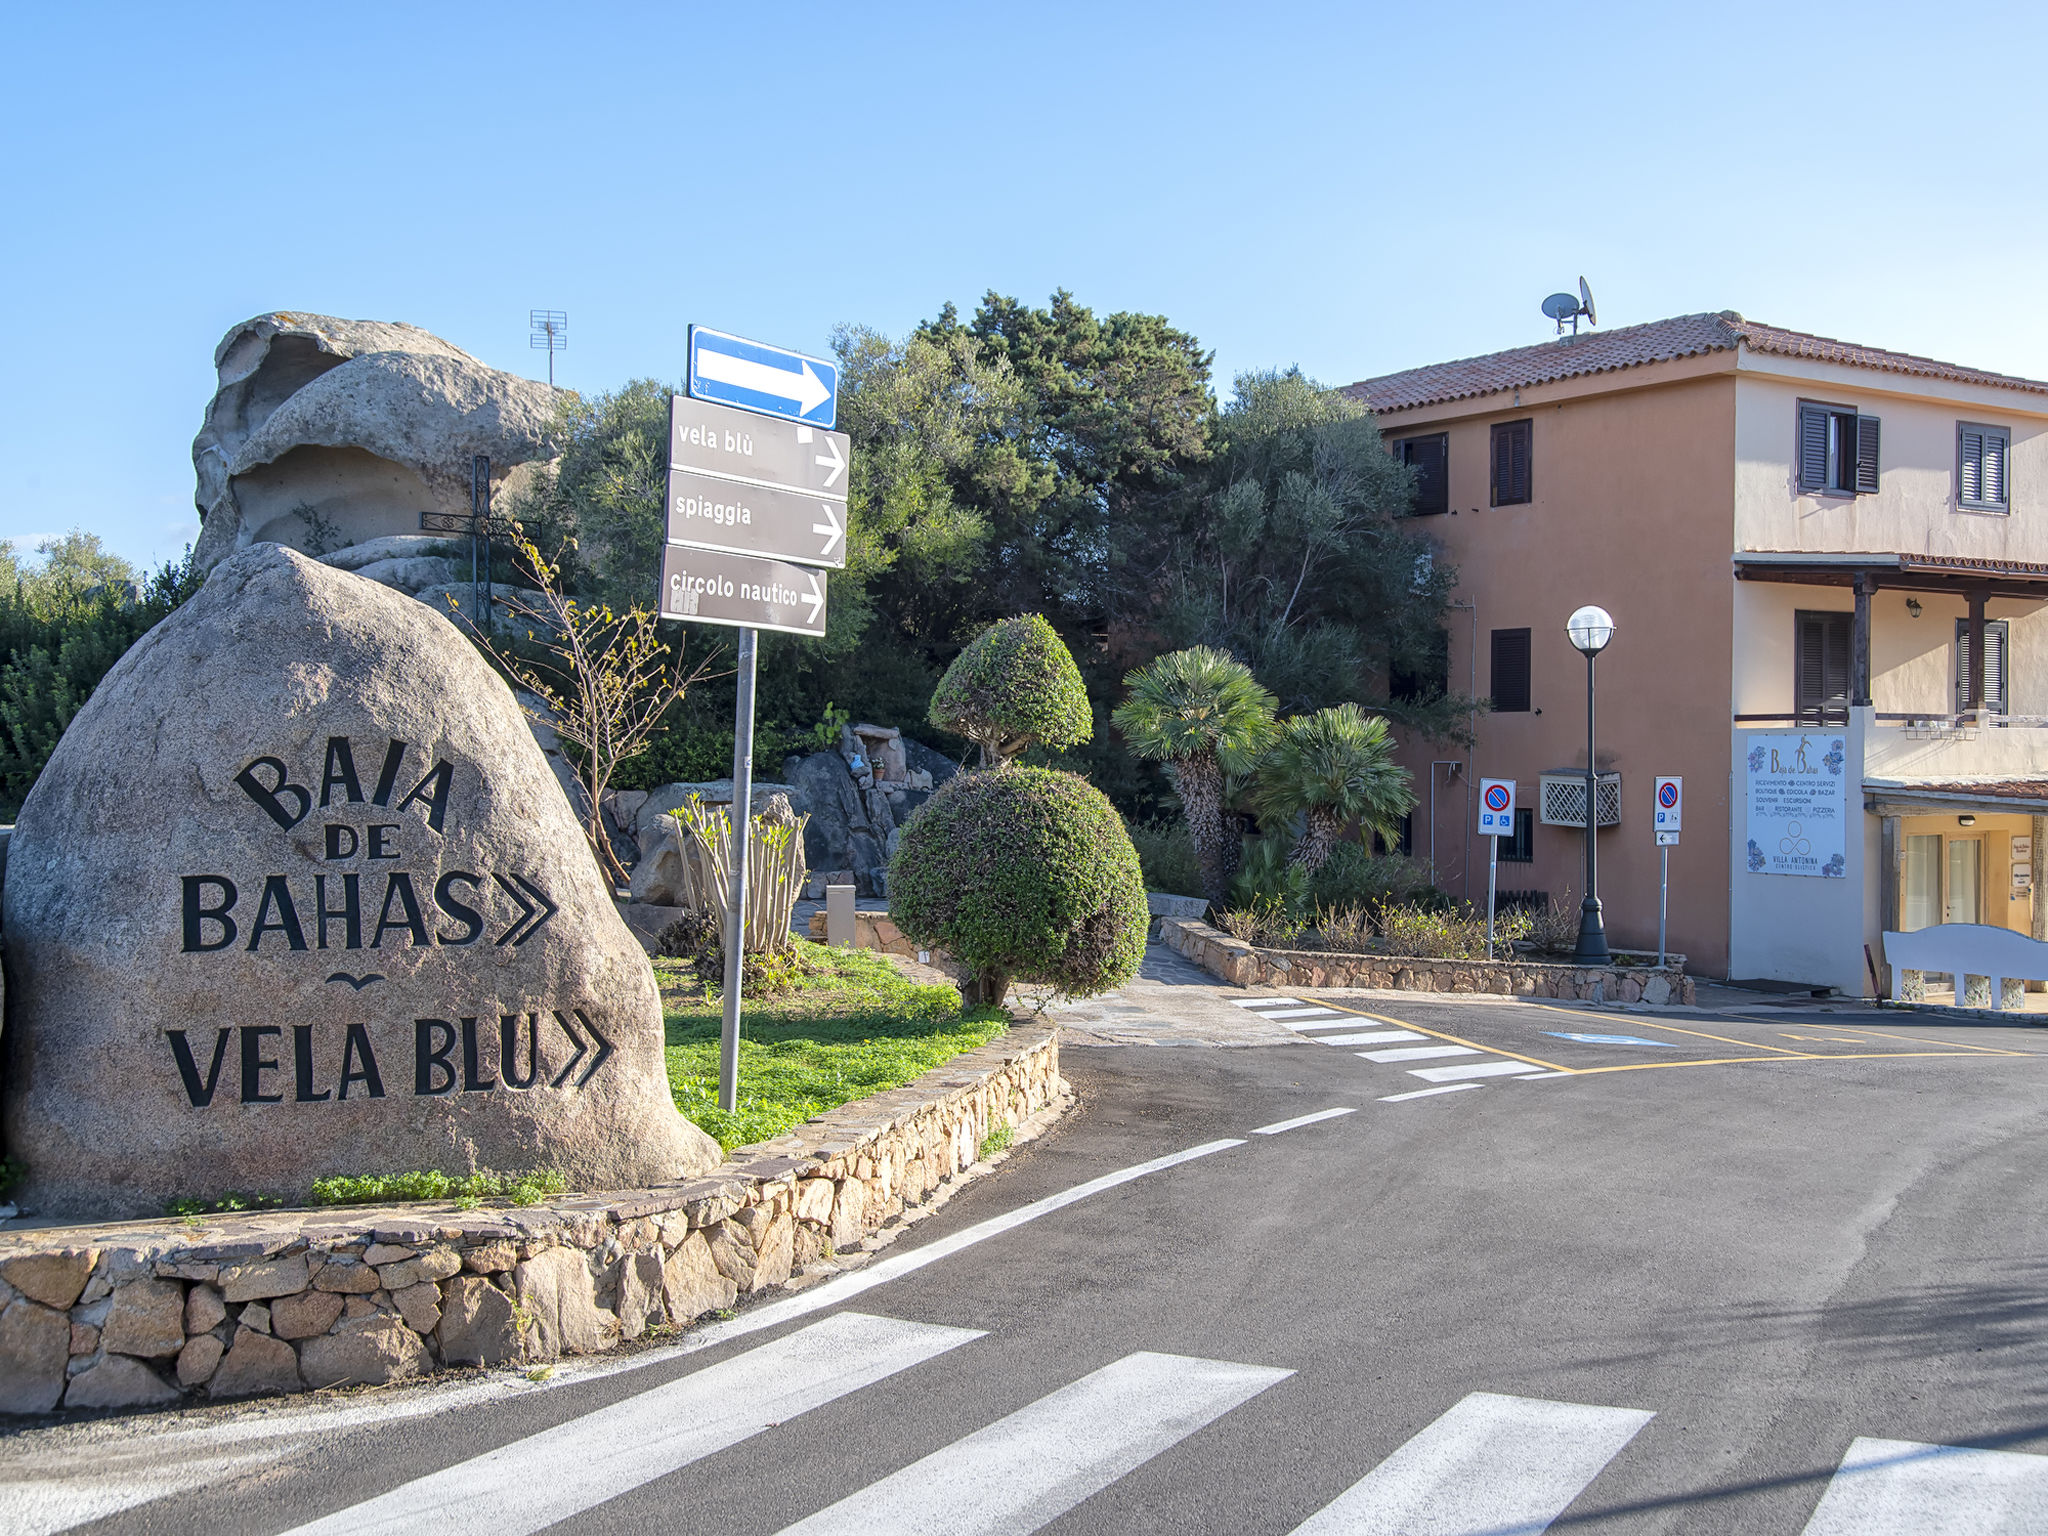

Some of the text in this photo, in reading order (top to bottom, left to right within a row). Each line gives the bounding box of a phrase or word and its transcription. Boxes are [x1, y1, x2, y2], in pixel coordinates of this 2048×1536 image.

[678, 423, 753, 456] vela blù
[675, 495, 751, 525] spiaggia
[670, 570, 798, 607] circolo nautico
[233, 735, 455, 835] BAIA
[1755, 788, 1836, 797] BOUTIQUE EDICOLA BAZAR
[1795, 780, 1816, 788] CENTRO
[1816, 780, 1836, 788] SERVIZI
[1484, 815, 1491, 824] P
[1812, 806, 1836, 814] PIZZERIA
[324, 823, 401, 860] DE
[1773, 856, 1788, 864] VILLA
[180, 870, 486, 954] BAHAS
[165, 1012, 538, 1108] VELA BLU
